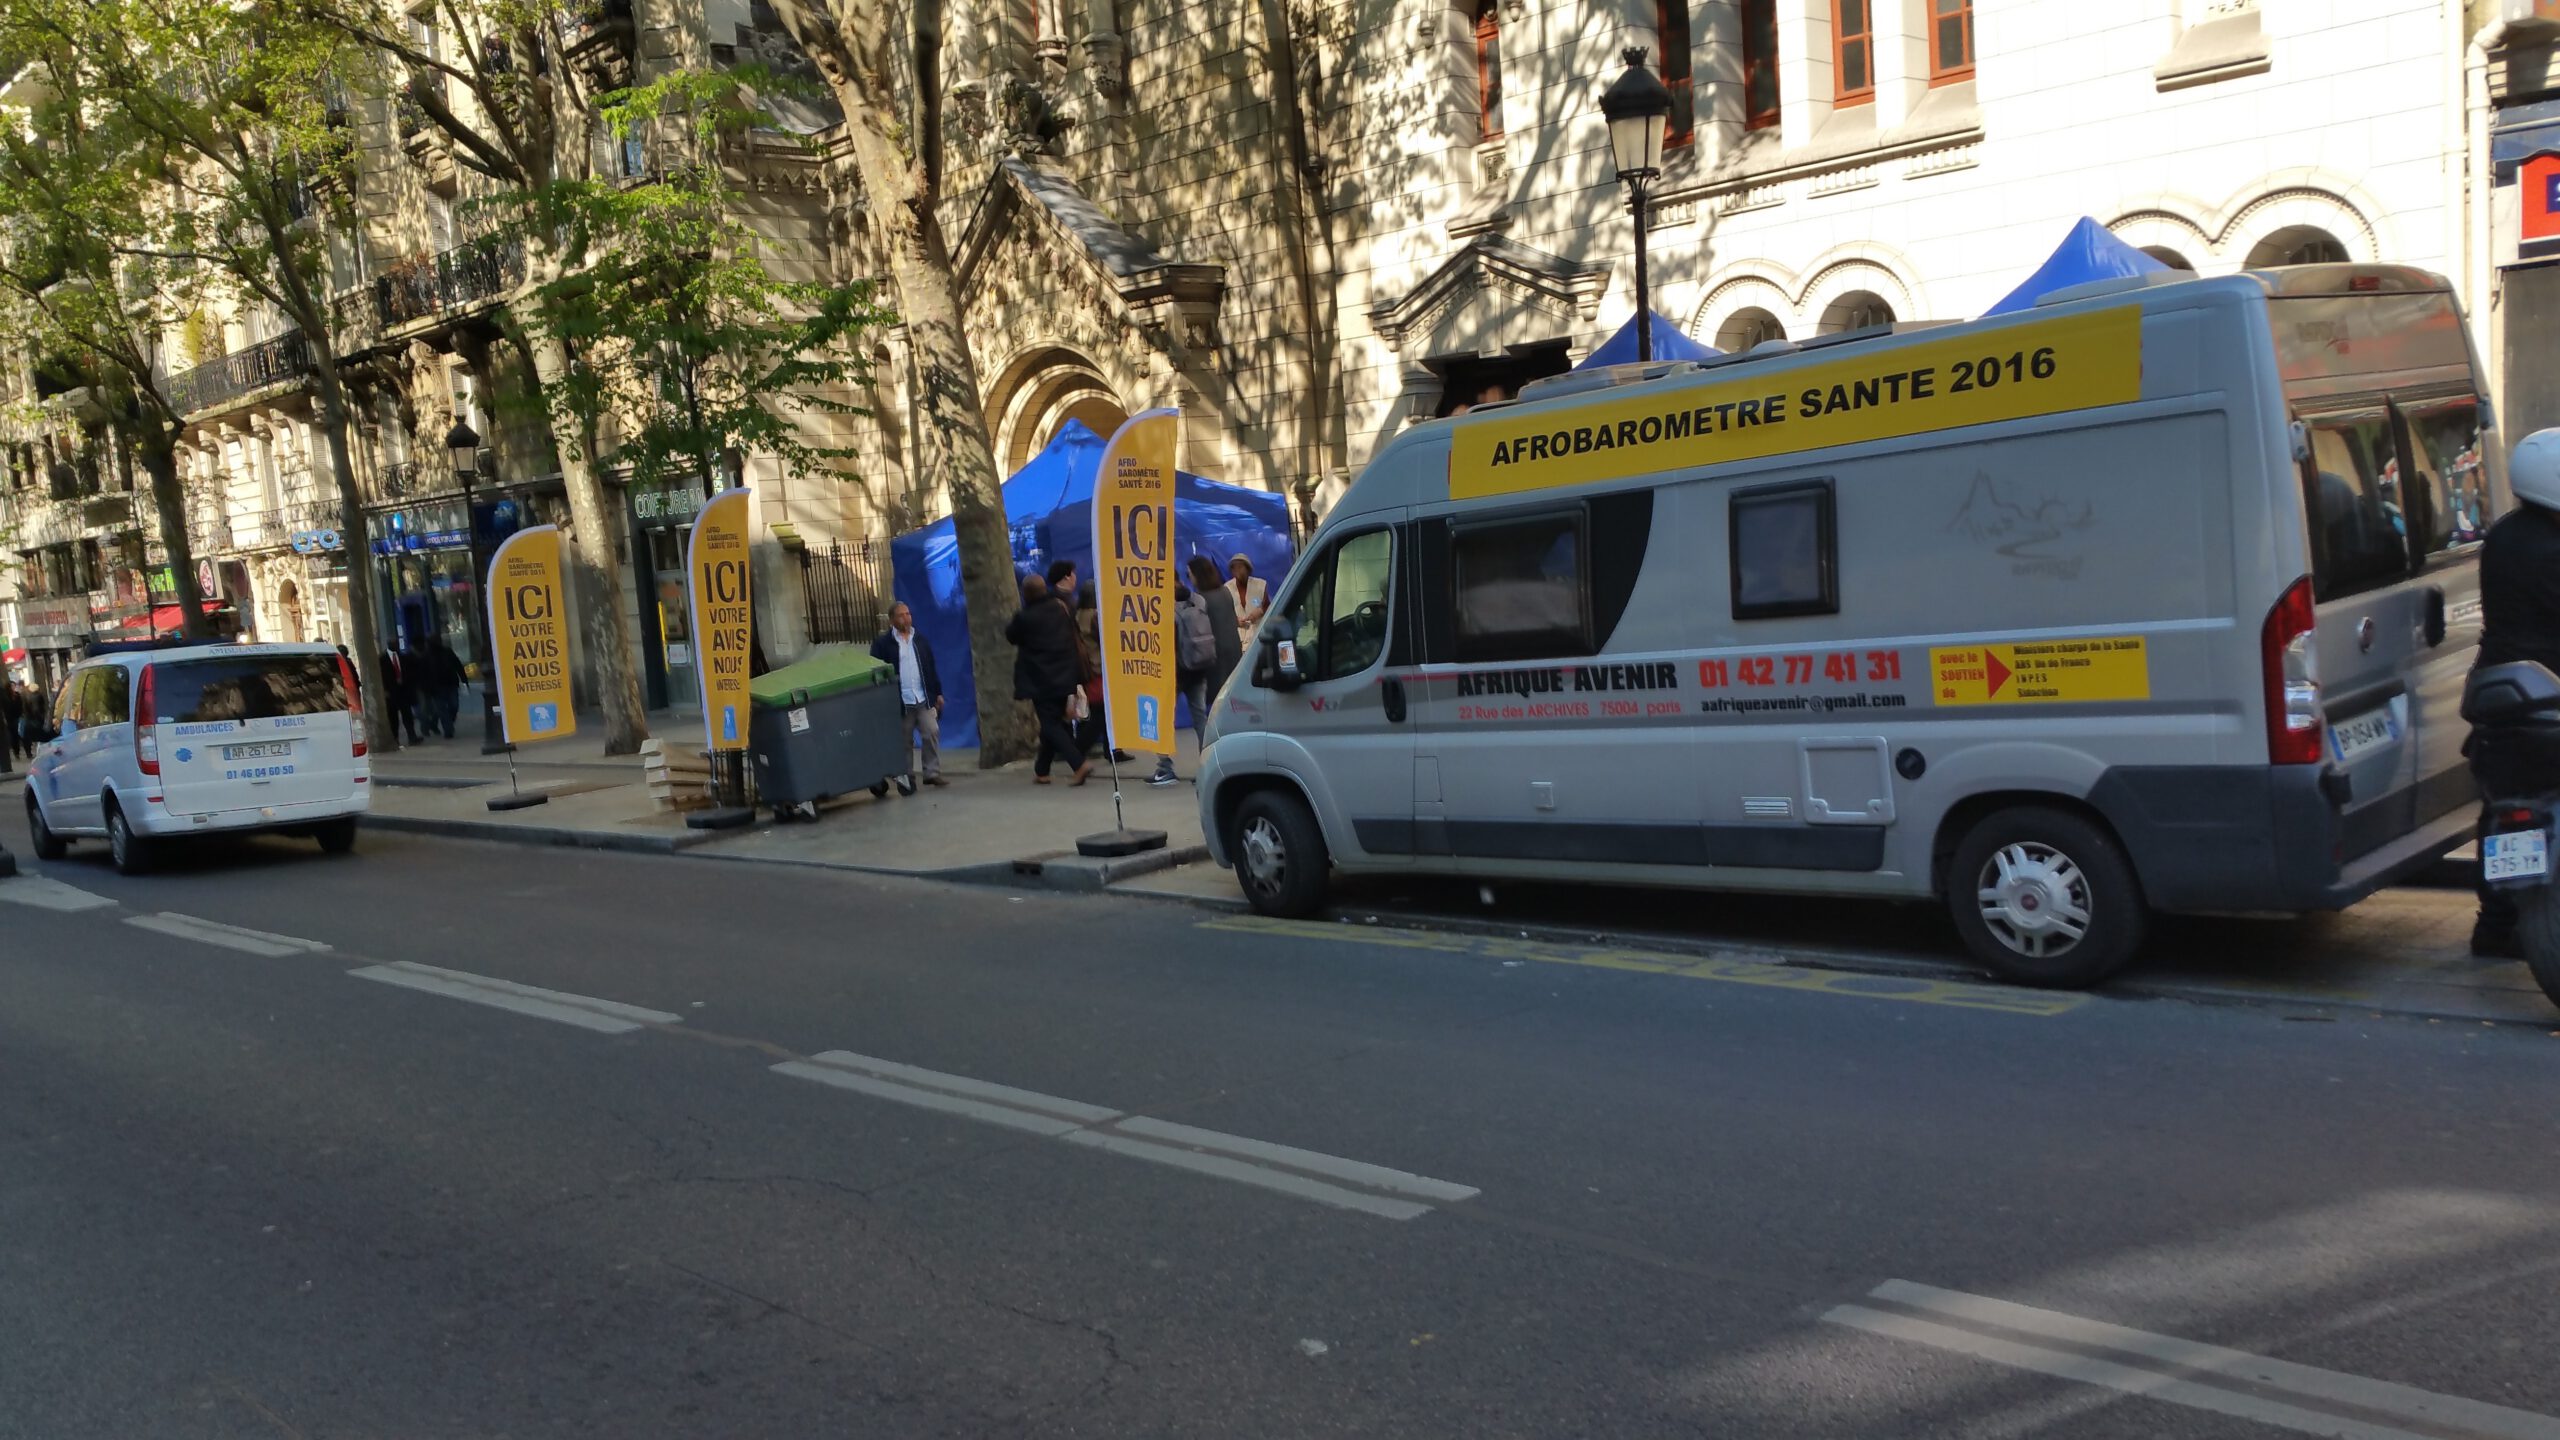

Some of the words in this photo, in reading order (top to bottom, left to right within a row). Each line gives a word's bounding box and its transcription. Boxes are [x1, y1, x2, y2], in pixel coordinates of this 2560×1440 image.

[1490, 394, 1788, 467] AFROBAROMETRE
[1798, 367, 1936, 419] SANTE
[1949, 347, 2057, 394] 2016
[1118, 458, 1137, 467] AFRO
[1112, 503, 1167, 561] ICI
[703, 560, 747, 604] ICI
[504, 584, 553, 621] ICI
[1119, 594, 1162, 626] AVS
[709, 607, 747, 625] VOTRE
[510, 621, 555, 638] VOTRE
[712, 628, 748, 651] AVIS
[513, 639, 560, 661] AVIS
[514, 661, 561, 679] NOUS
[1456, 667, 1565, 698] AFRIQUE
[1573, 661, 1679, 692] AVENIR
[1698, 658, 1729, 688] 01
[1737, 657, 1776, 686] 42
[1783, 655, 1814, 684] 77
[1824, 652, 1858, 683] 41
[1866, 649, 1902, 681] 31
[1940, 668, 1985, 682] SOUTIEN
[1458, 705, 1473, 720] 22
[1475, 703, 1498, 720] Rue
[1502, 702, 1524, 719] des
[1527, 701, 1590, 719] ARCHIVES
[1599, 699, 1639, 716] 75004
[1646, 699, 1682, 717] paris
[175, 722, 234, 736] AMBULANCES
[226, 770, 238, 779] 01
[240, 768, 253, 778] 46
[255, 767, 267, 777] 04
[269, 766, 281, 776] 60
[282, 765, 295, 774] 50
